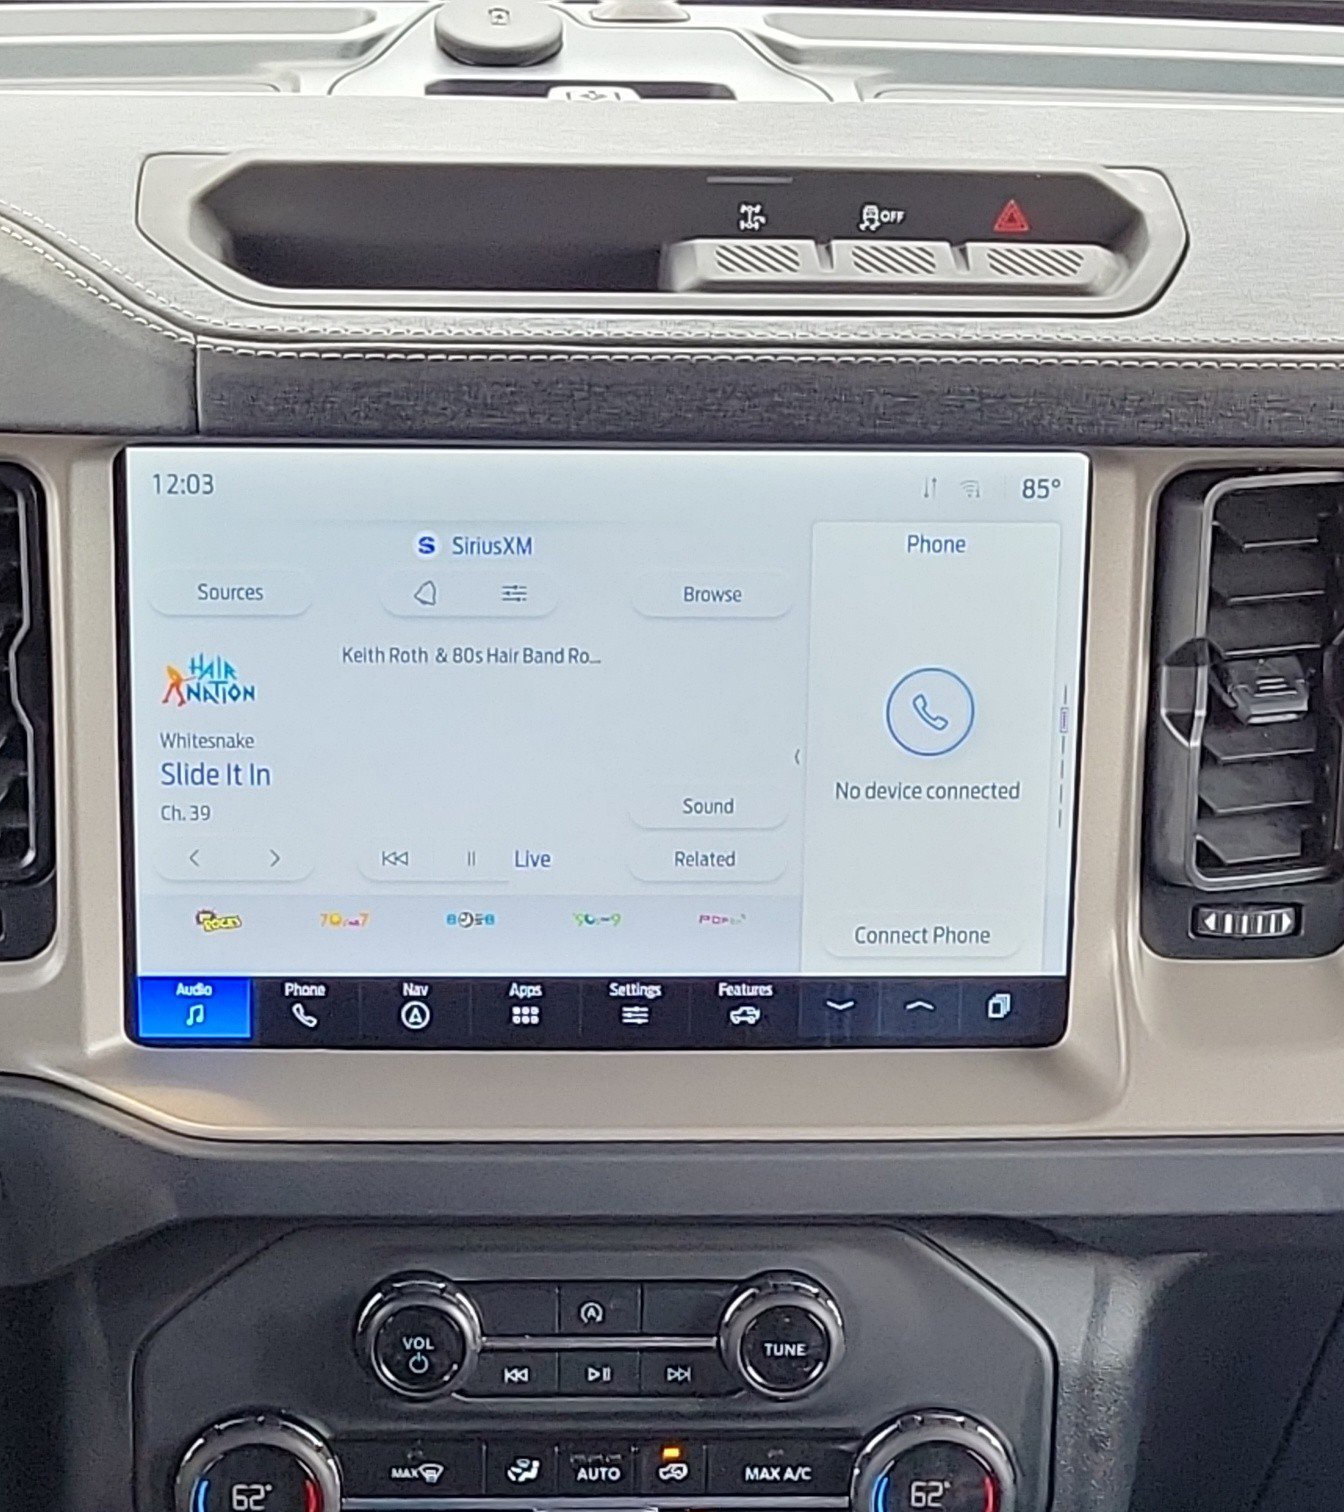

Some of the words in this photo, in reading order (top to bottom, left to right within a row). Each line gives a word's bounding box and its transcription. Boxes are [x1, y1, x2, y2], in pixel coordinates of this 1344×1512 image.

[880, 210, 904, 223] OFF
[151, 473, 215, 496] 12:03
[1022, 477, 1062, 499] 85°
[451, 535, 533, 557] SiriusXM
[907, 534, 967, 554] Phone
[197, 583, 264, 602] Sources
[683, 585, 742, 604] Browse
[342, 646, 385, 664] Keith
[389, 646, 428, 664] Roth
[435, 646, 448, 664] &
[452, 646, 483, 664] 80s
[487, 646, 518, 664] Hair
[522, 646, 565, 664] Band
[160, 732, 255, 749] Whitesnake
[161, 761, 220, 786] Slide
[227, 762, 243, 786] It
[250, 762, 271, 786] In
[835, 781, 861, 800] No
[865, 781, 922, 800] device
[926, 781, 1021, 800] connected
[161, 804, 187, 822] Ch.
[190, 804, 211, 822] 39
[683, 797, 735, 815] Sound
[514, 850, 552, 869] Live
[674, 850, 736, 868] Related
[854, 926, 928, 944] Connect
[933, 926, 991, 944] Phone
[176, 981, 213, 997] Audio
[284, 982, 326, 997] Phone
[402, 982, 428, 997] Nav
[510, 981, 542, 1000] Apps
[608, 981, 662, 999] Settings
[718, 981, 773, 997] Features
[402, 1336, 435, 1351] VOL
[764, 1342, 806, 1357] TUNE
[391, 1466, 419, 1479] MAX
[577, 1466, 621, 1482] AUTO
[745, 1466, 781, 1481] MAX
[784, 1466, 812, 1481] A/C
